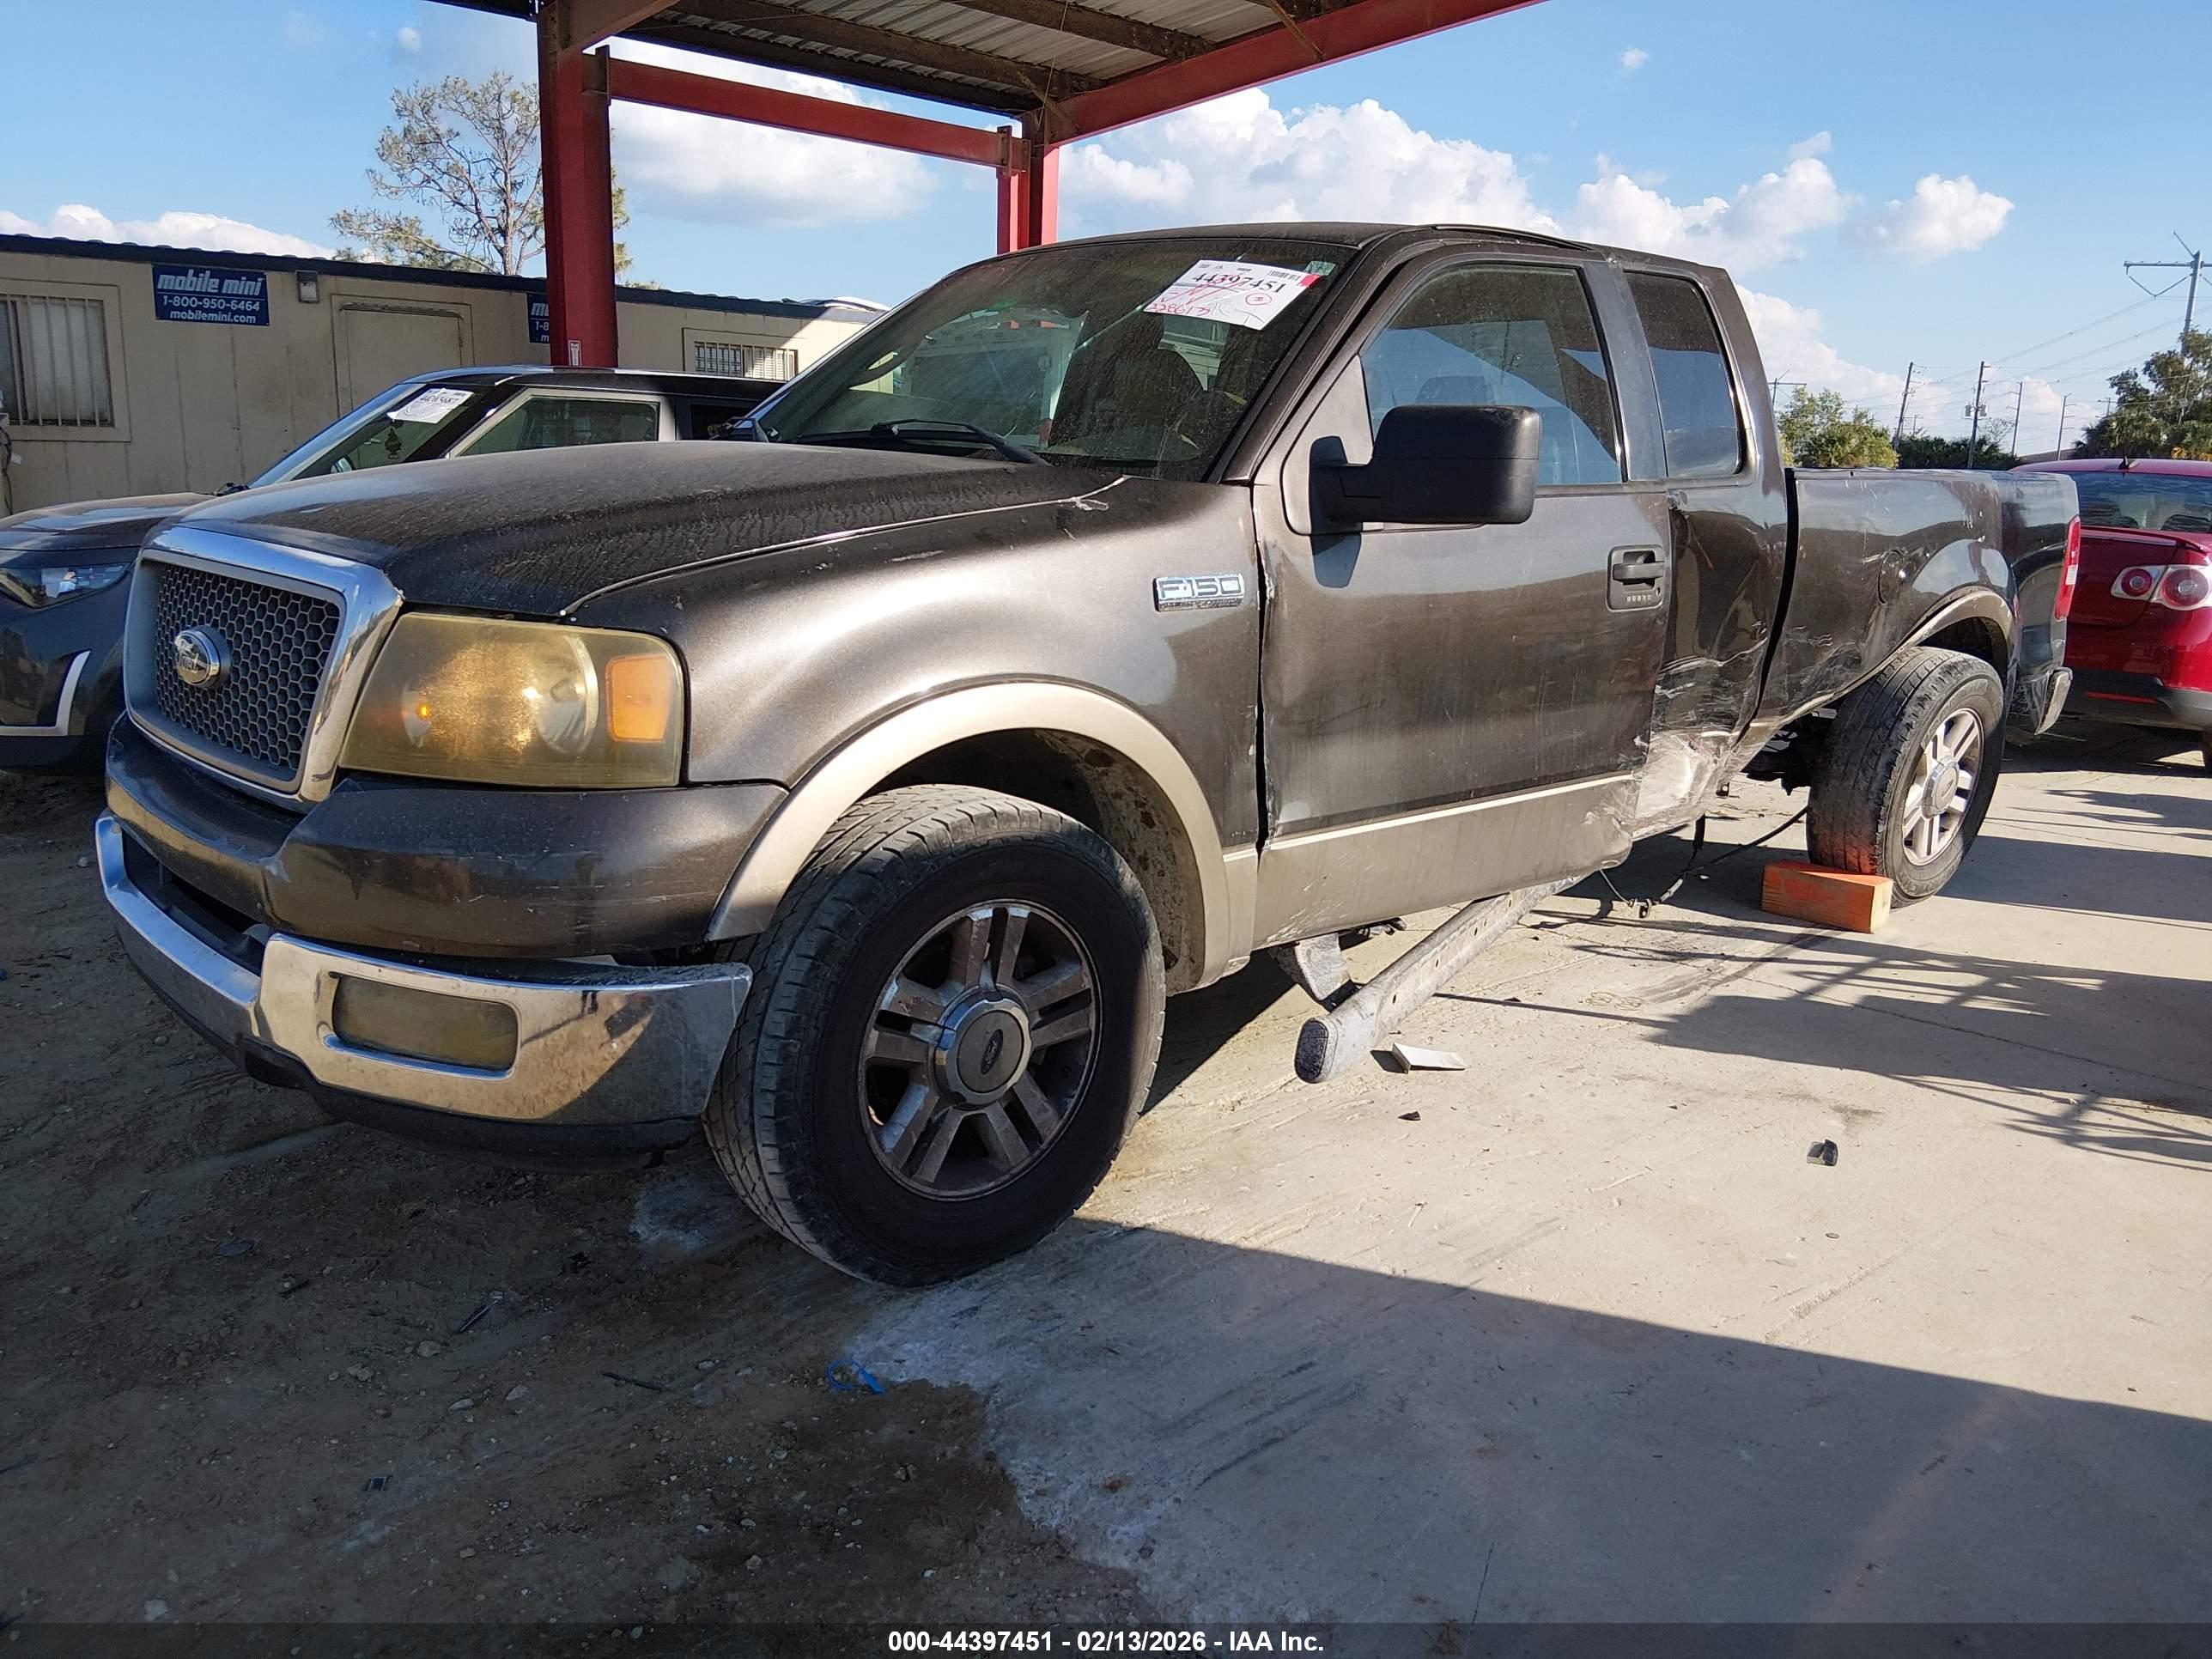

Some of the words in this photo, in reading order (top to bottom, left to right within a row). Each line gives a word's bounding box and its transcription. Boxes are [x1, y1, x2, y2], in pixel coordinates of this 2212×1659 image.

[157, 269, 220, 293] mobile
[222, 276, 265, 296] mini
[1192, 273, 1286, 293] 44397451
[162, 295, 261, 312] 1-800-950-6464
[169, 309, 257, 324] mobilemini.com
